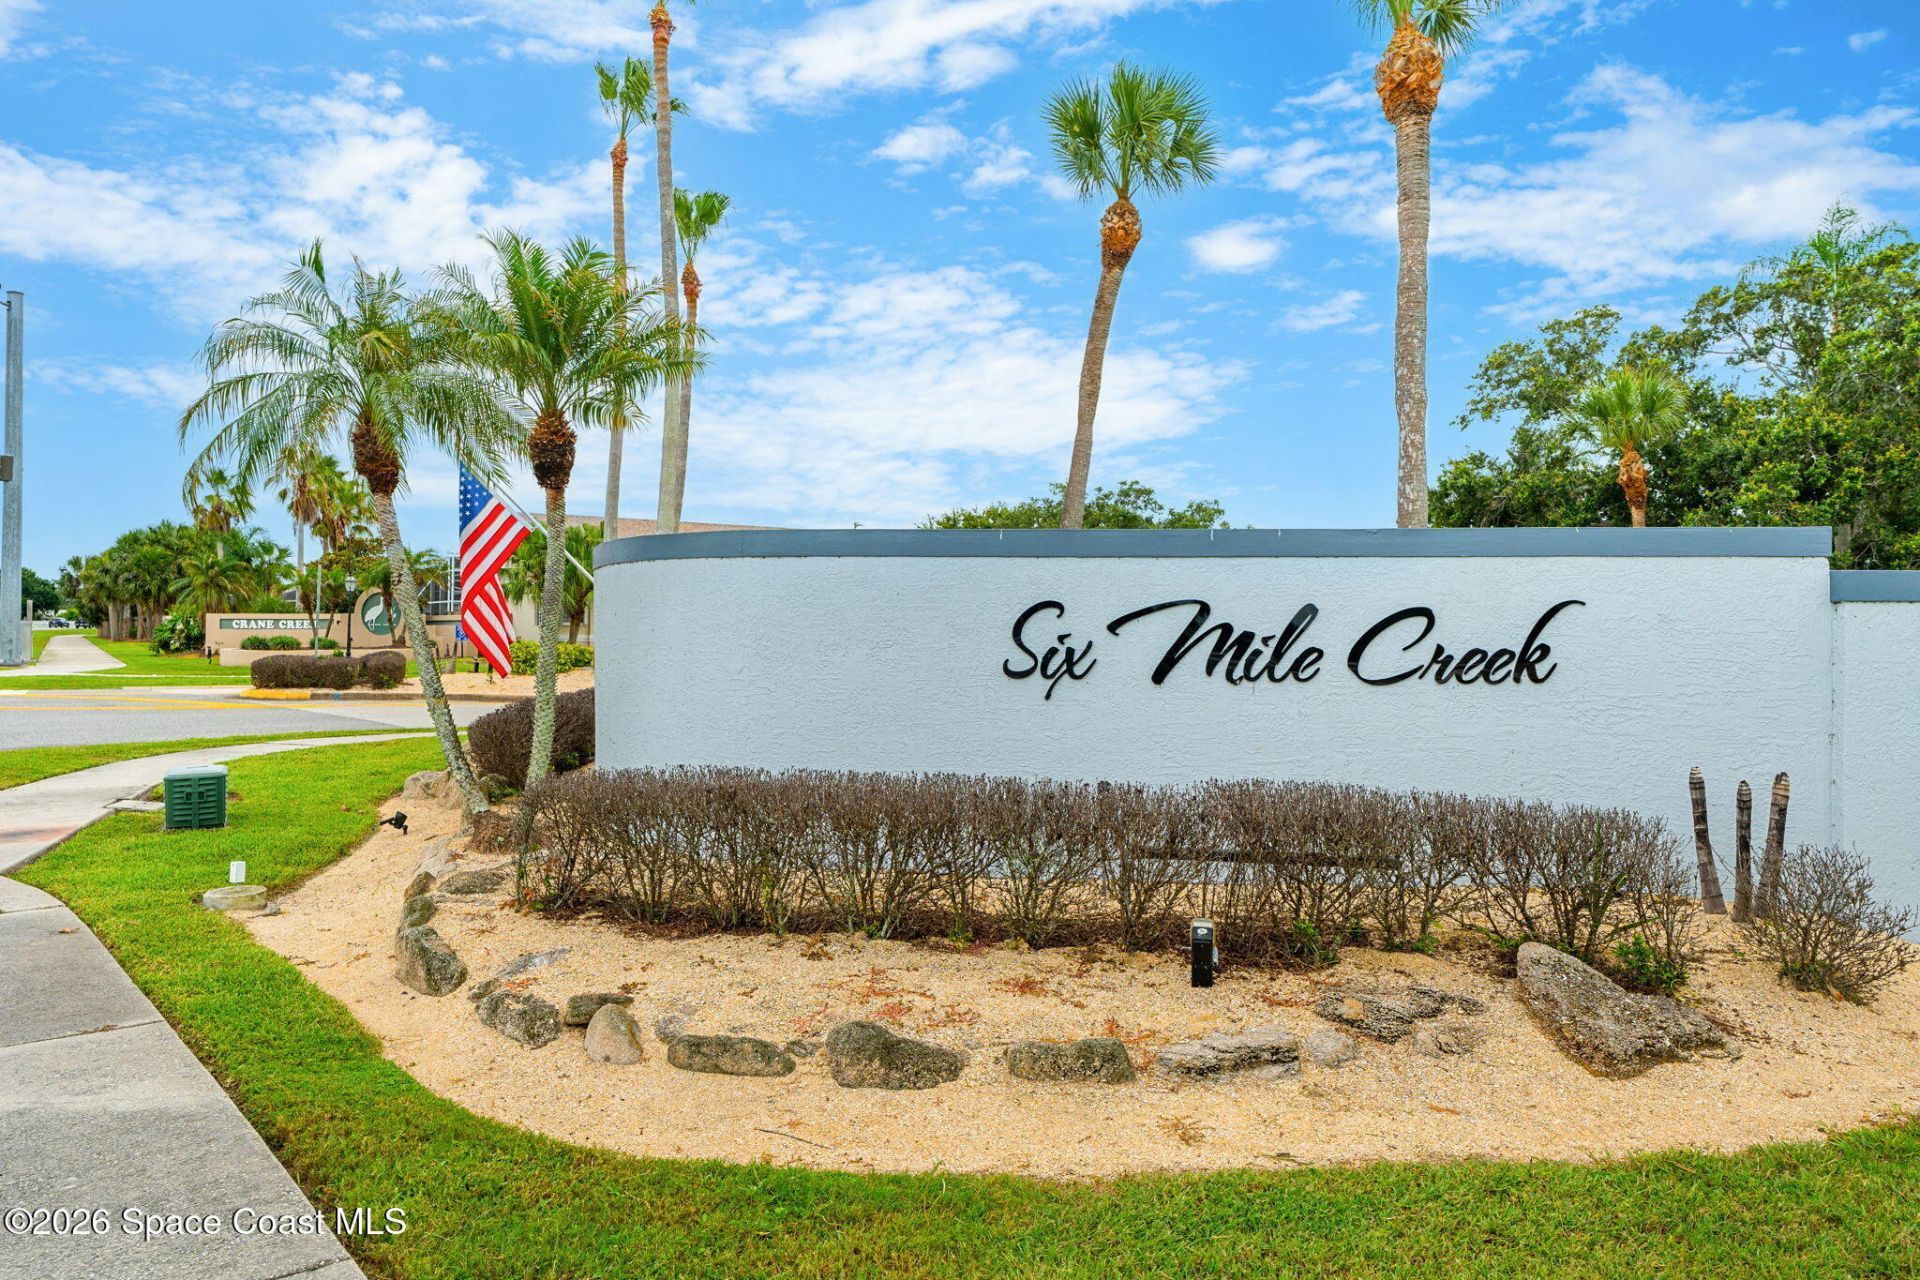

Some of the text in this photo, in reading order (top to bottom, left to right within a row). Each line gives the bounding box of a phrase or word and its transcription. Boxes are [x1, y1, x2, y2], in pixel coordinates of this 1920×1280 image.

[232, 619, 274, 629] CRANE
[1002, 599, 1586, 700] Six Mile Creek
